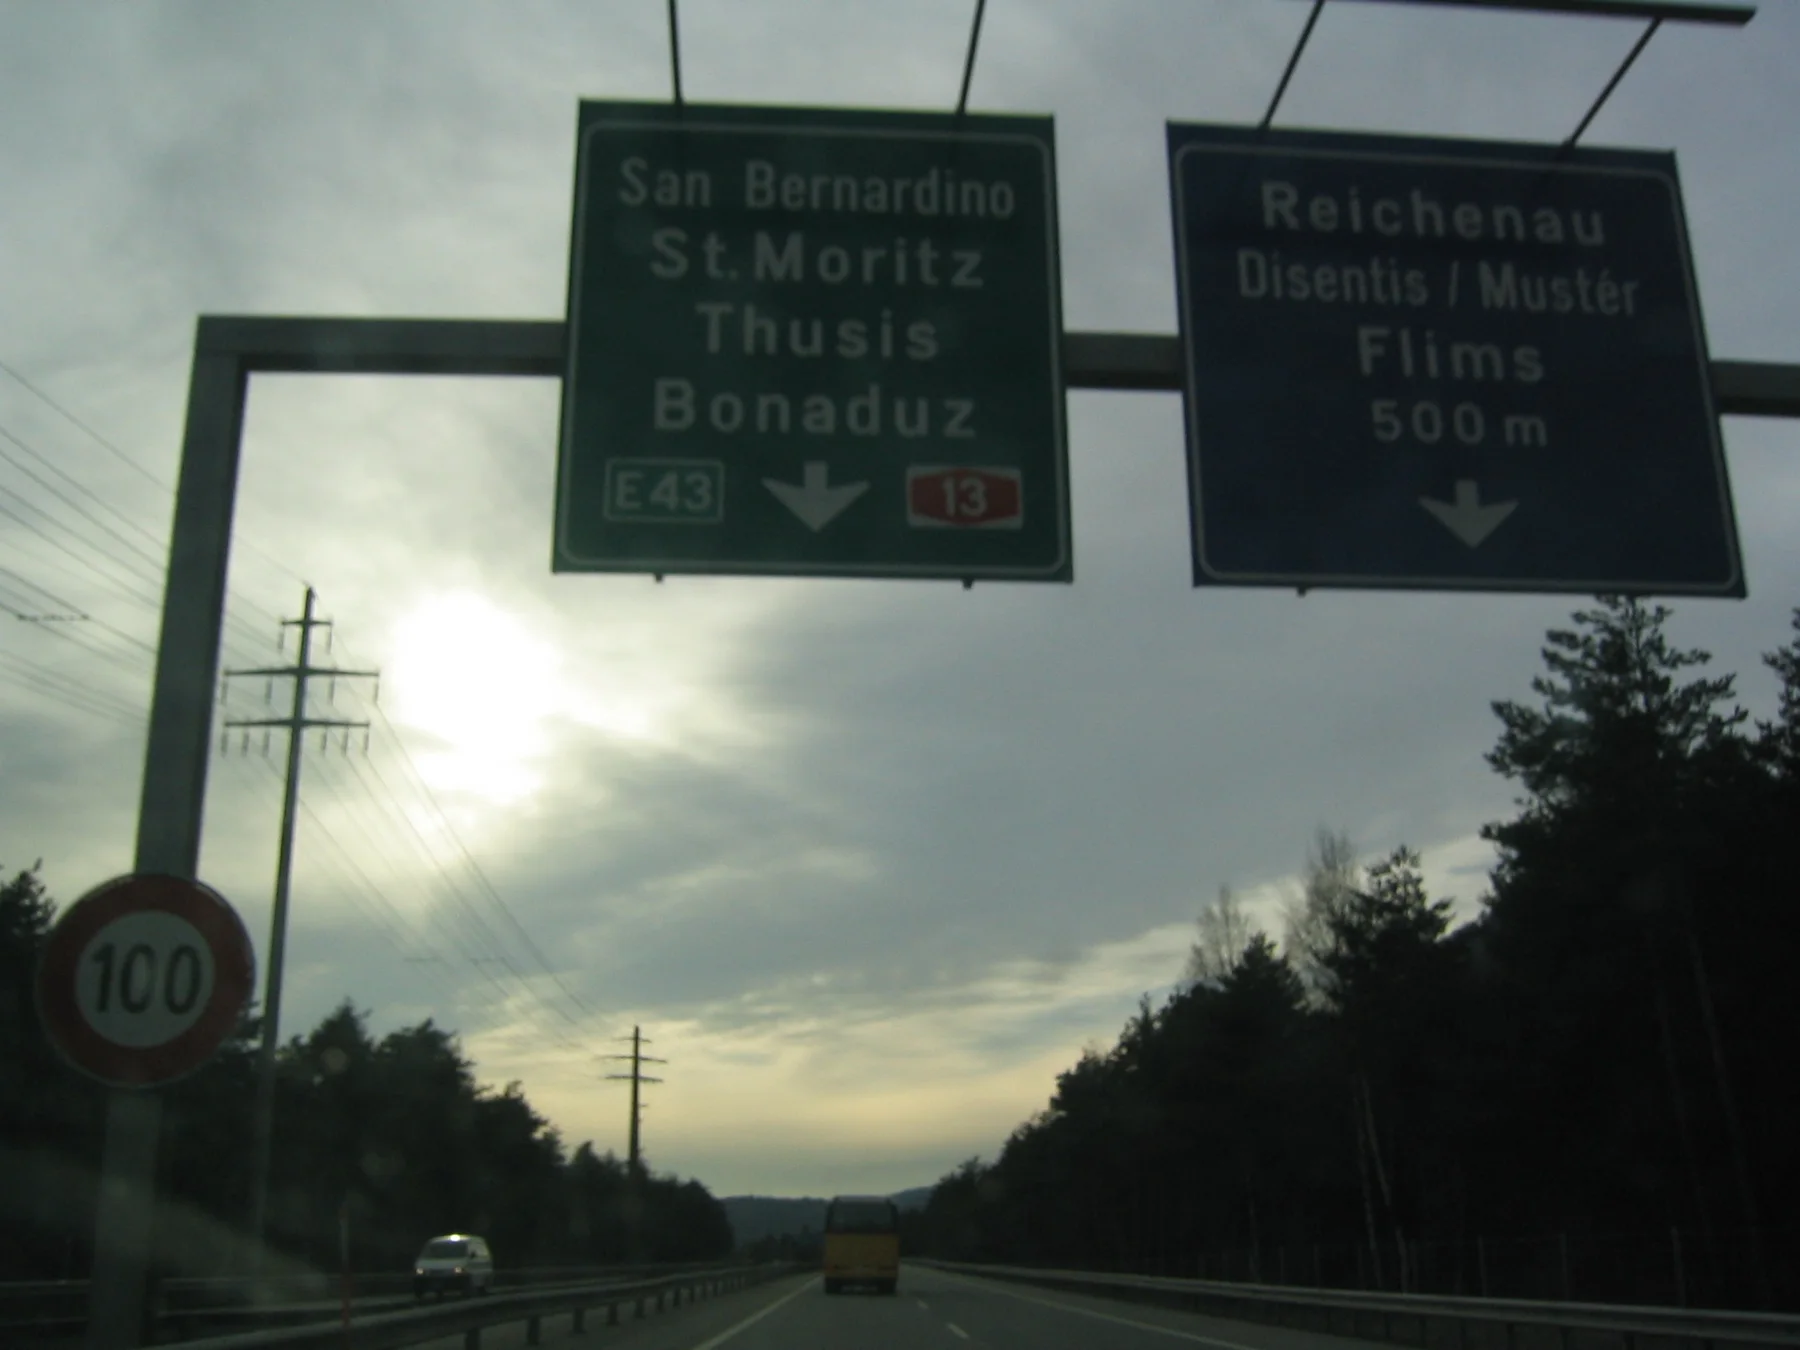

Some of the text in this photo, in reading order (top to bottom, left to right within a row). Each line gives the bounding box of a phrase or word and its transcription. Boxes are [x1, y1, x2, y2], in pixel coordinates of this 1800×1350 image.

[619, 157, 1015, 219] San Bernardino
[1261, 181, 1605, 245] Reichenau
[1237, 249, 1429, 305] Disentis
[1478, 259, 1640, 316] Mustér
[695, 303, 940, 360] Thusis
[1357, 326, 1545, 384] Flims
[652, 378, 977, 438] Bonaduz
[1372, 400, 1549, 447] 500 m
[942, 476, 989, 517] 13
[92, 943, 202, 1016] 100
